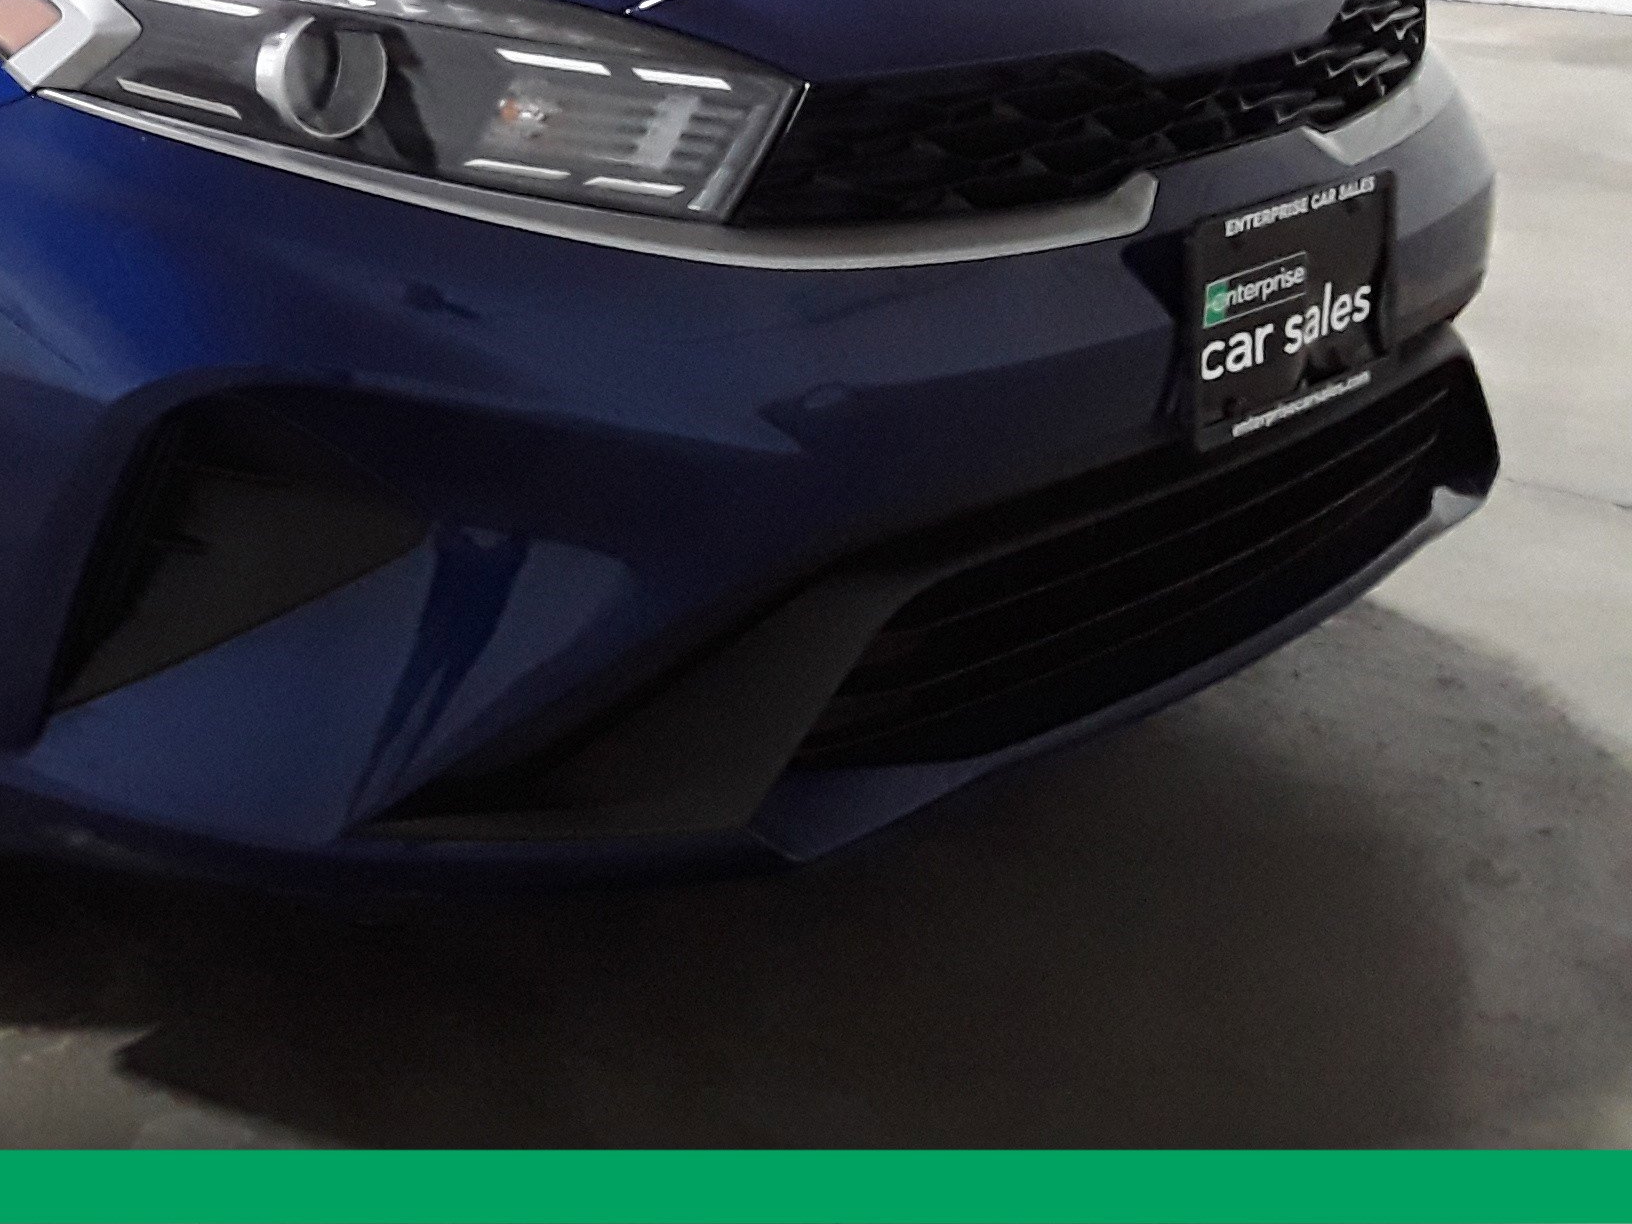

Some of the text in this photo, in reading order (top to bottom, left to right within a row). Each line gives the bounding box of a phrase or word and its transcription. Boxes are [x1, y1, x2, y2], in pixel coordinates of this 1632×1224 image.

[1224, 175, 1376, 238] ENTERPRISE CAR SALES
[1200, 281, 1372, 381] car sales
